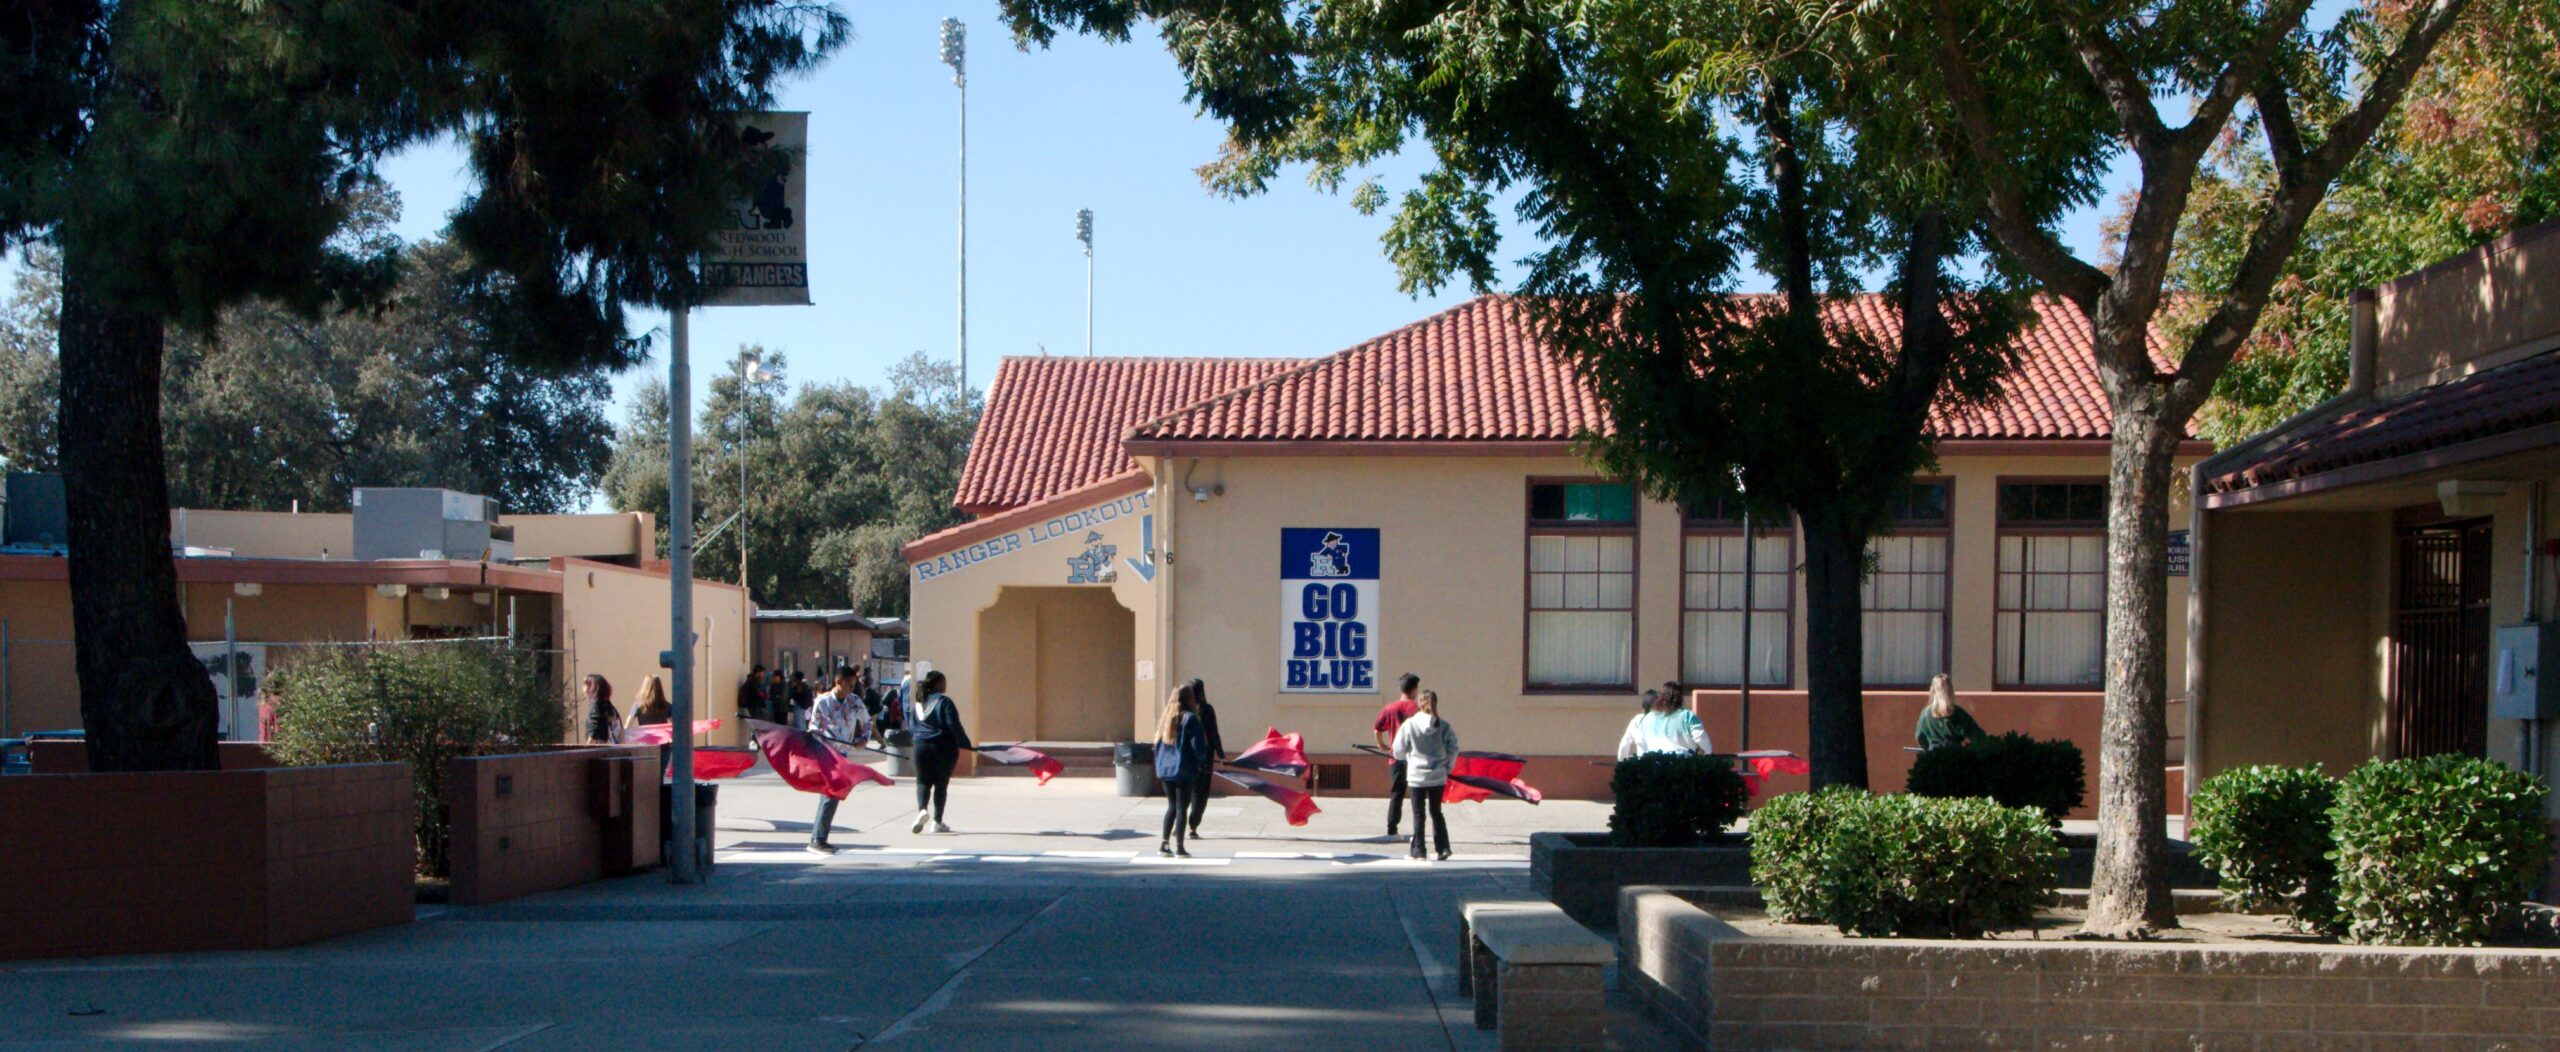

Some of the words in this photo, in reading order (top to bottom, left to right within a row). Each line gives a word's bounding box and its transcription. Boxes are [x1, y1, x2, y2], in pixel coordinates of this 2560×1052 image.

[719, 232, 786, 244] REDWOOD
[748, 244, 801, 256] SCHOOL
[914, 532, 1022, 584] RANGER
[1028, 491, 1151, 545] LOOKOUT
[1166, 552, 1174, 565] 6
[1302, 582, 1359, 622] GO
[1293, 621, 1368, 659] BIG
[1286, 659, 1373, 689] BLUE
